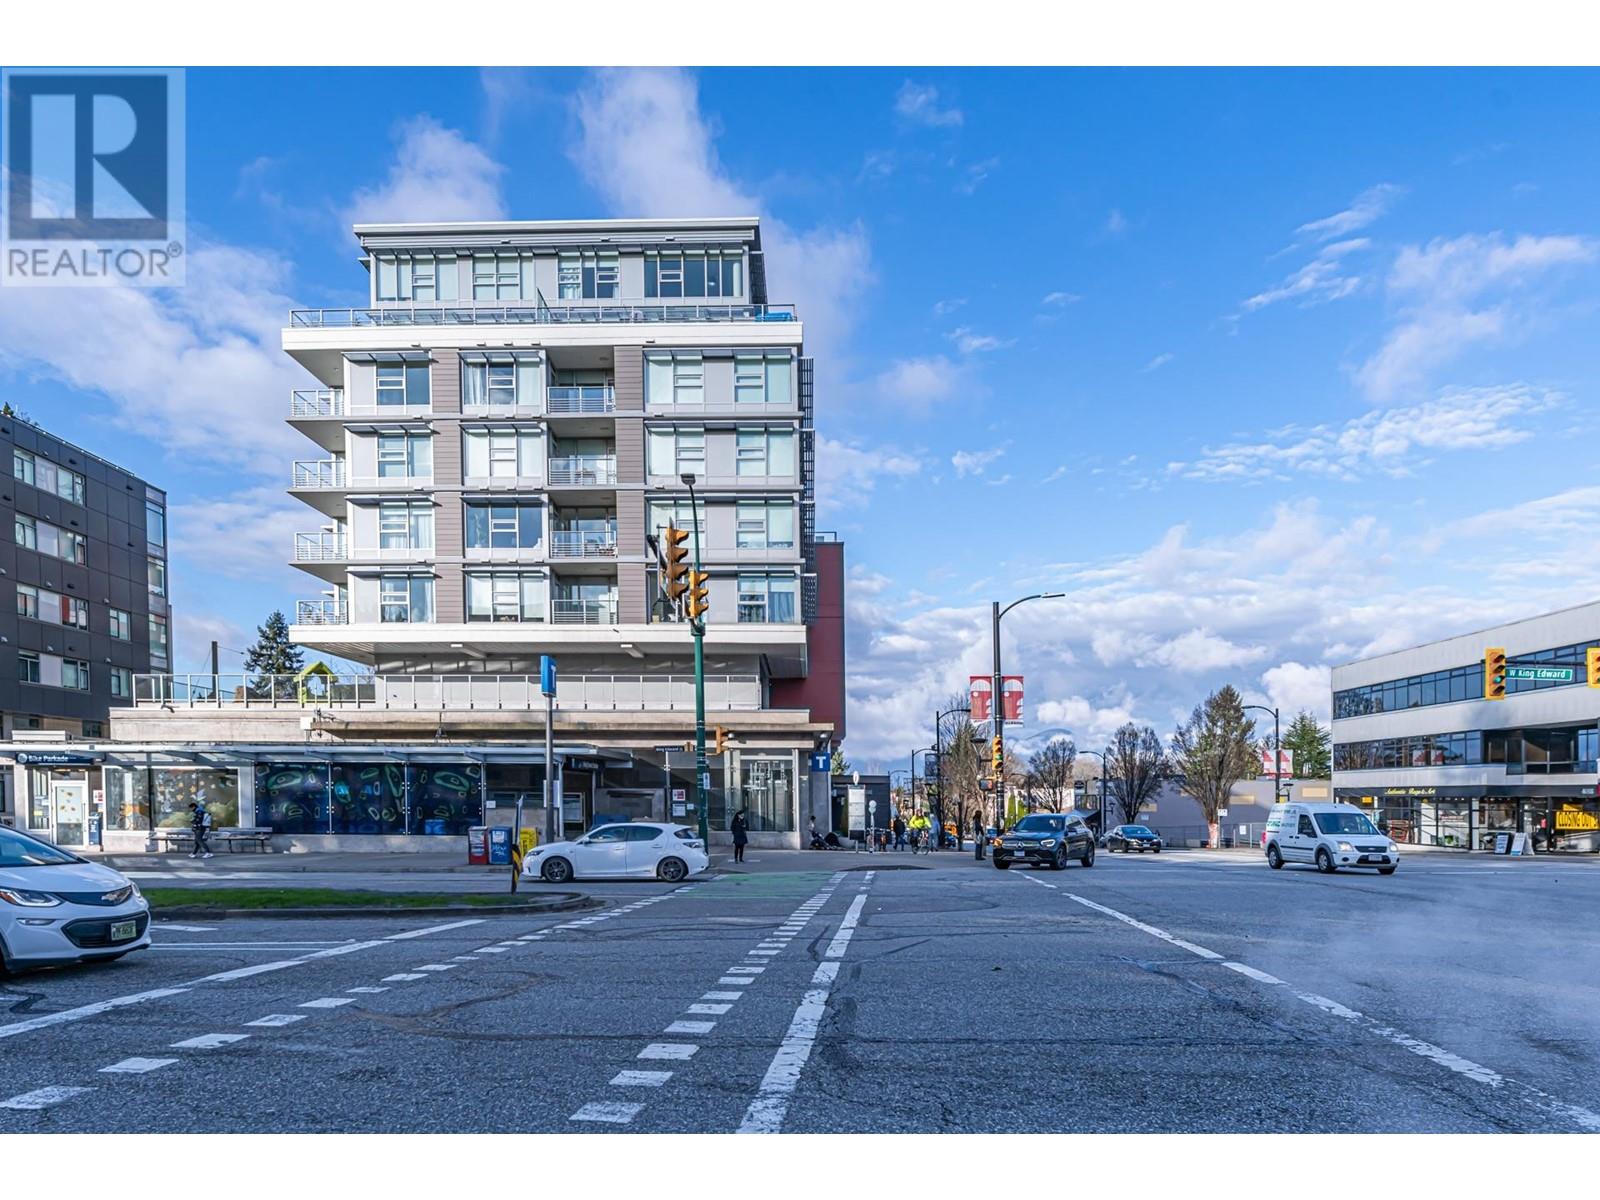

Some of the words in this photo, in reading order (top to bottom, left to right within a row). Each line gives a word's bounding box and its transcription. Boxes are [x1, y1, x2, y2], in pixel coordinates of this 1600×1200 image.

[1518, 669, 1534, 680] King
[1537, 668, 1566, 679] Edward
[28, 754, 42, 762] Bike
[43, 754, 69, 762] Parkade
[815, 756, 827, 769] T
[1558, 812, 1580, 827] CLOSING
